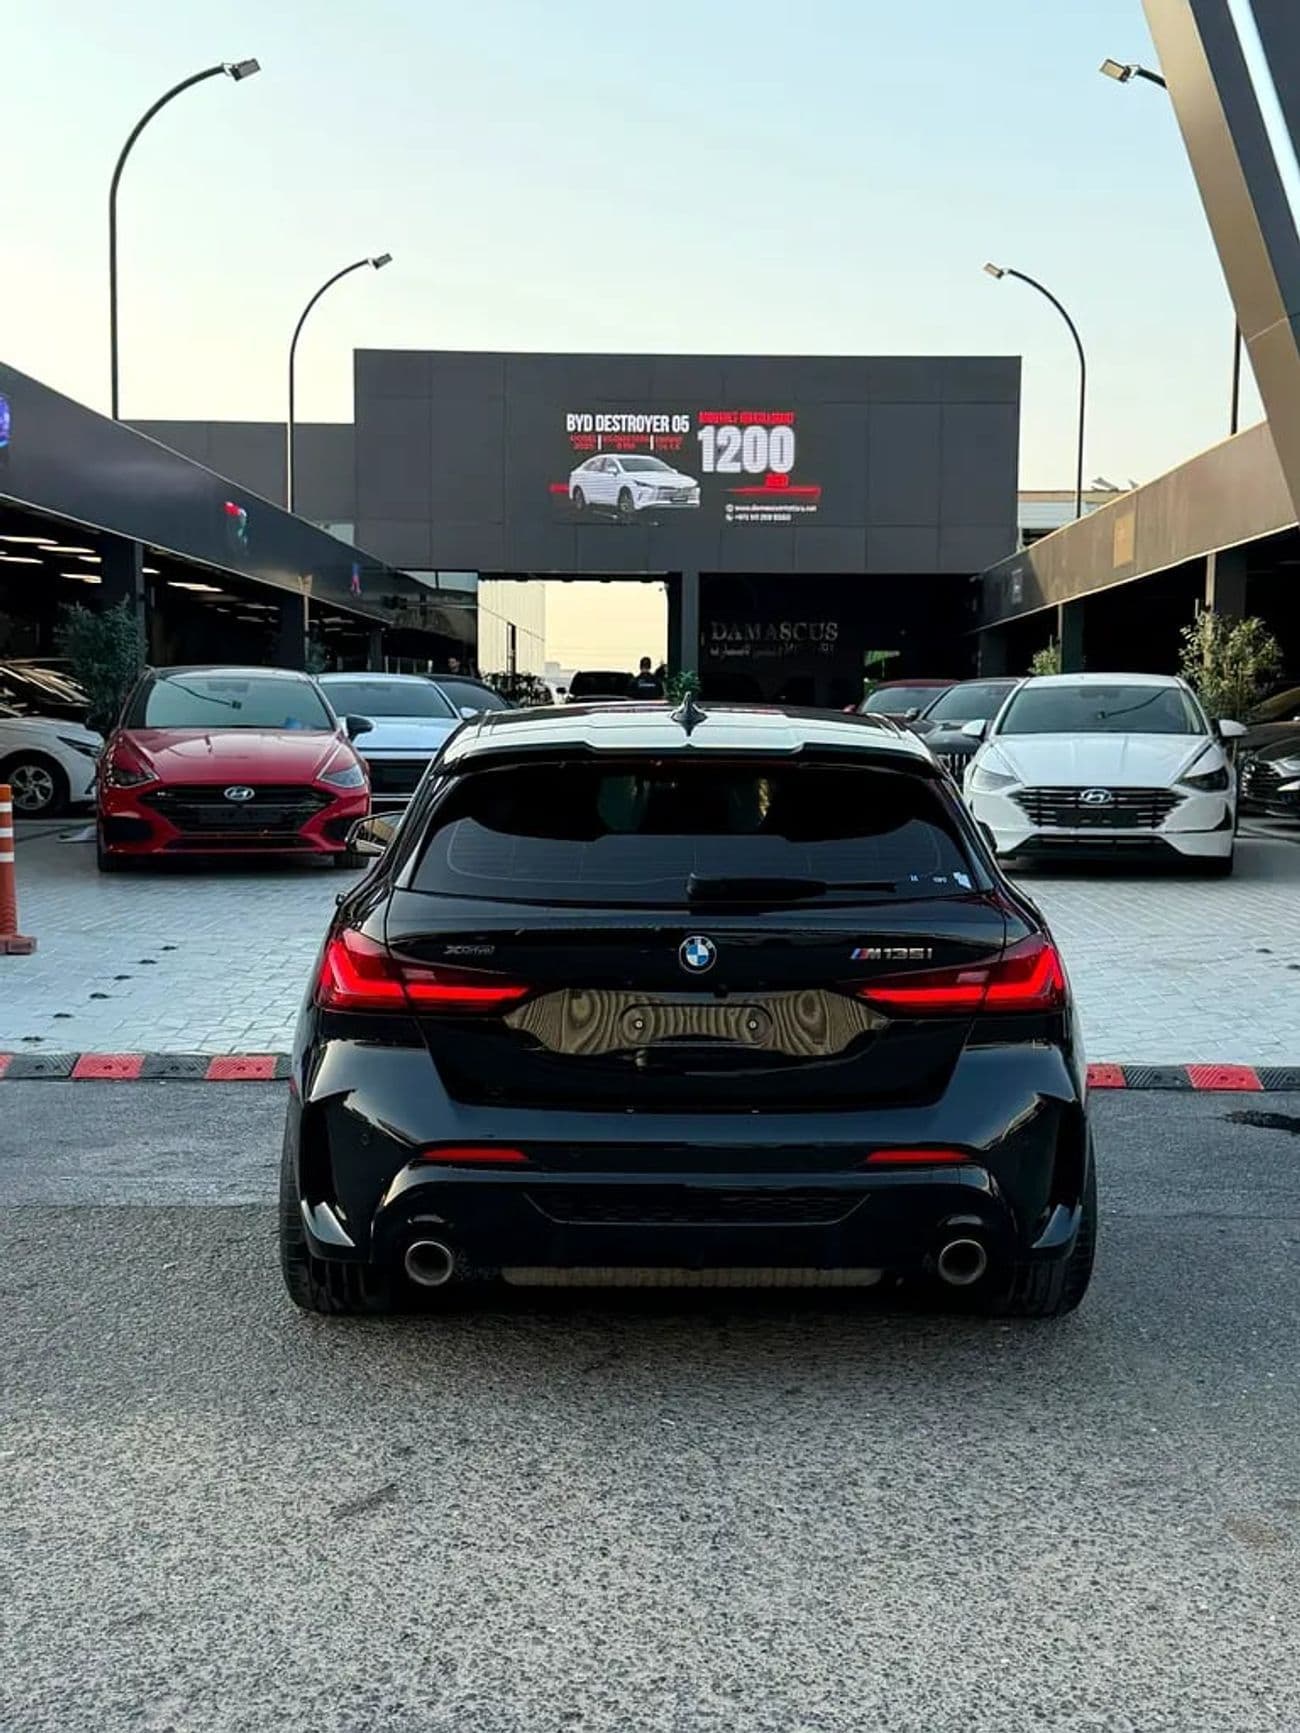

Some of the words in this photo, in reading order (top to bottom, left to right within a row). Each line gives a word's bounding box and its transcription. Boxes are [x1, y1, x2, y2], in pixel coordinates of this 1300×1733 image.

[566, 413, 593, 432] BYD
[595, 414, 670, 433] DESTROYER
[672, 414, 690, 433] 05
[697, 425, 795, 474] 1200
[710, 621, 839, 641] DAMASCUS
